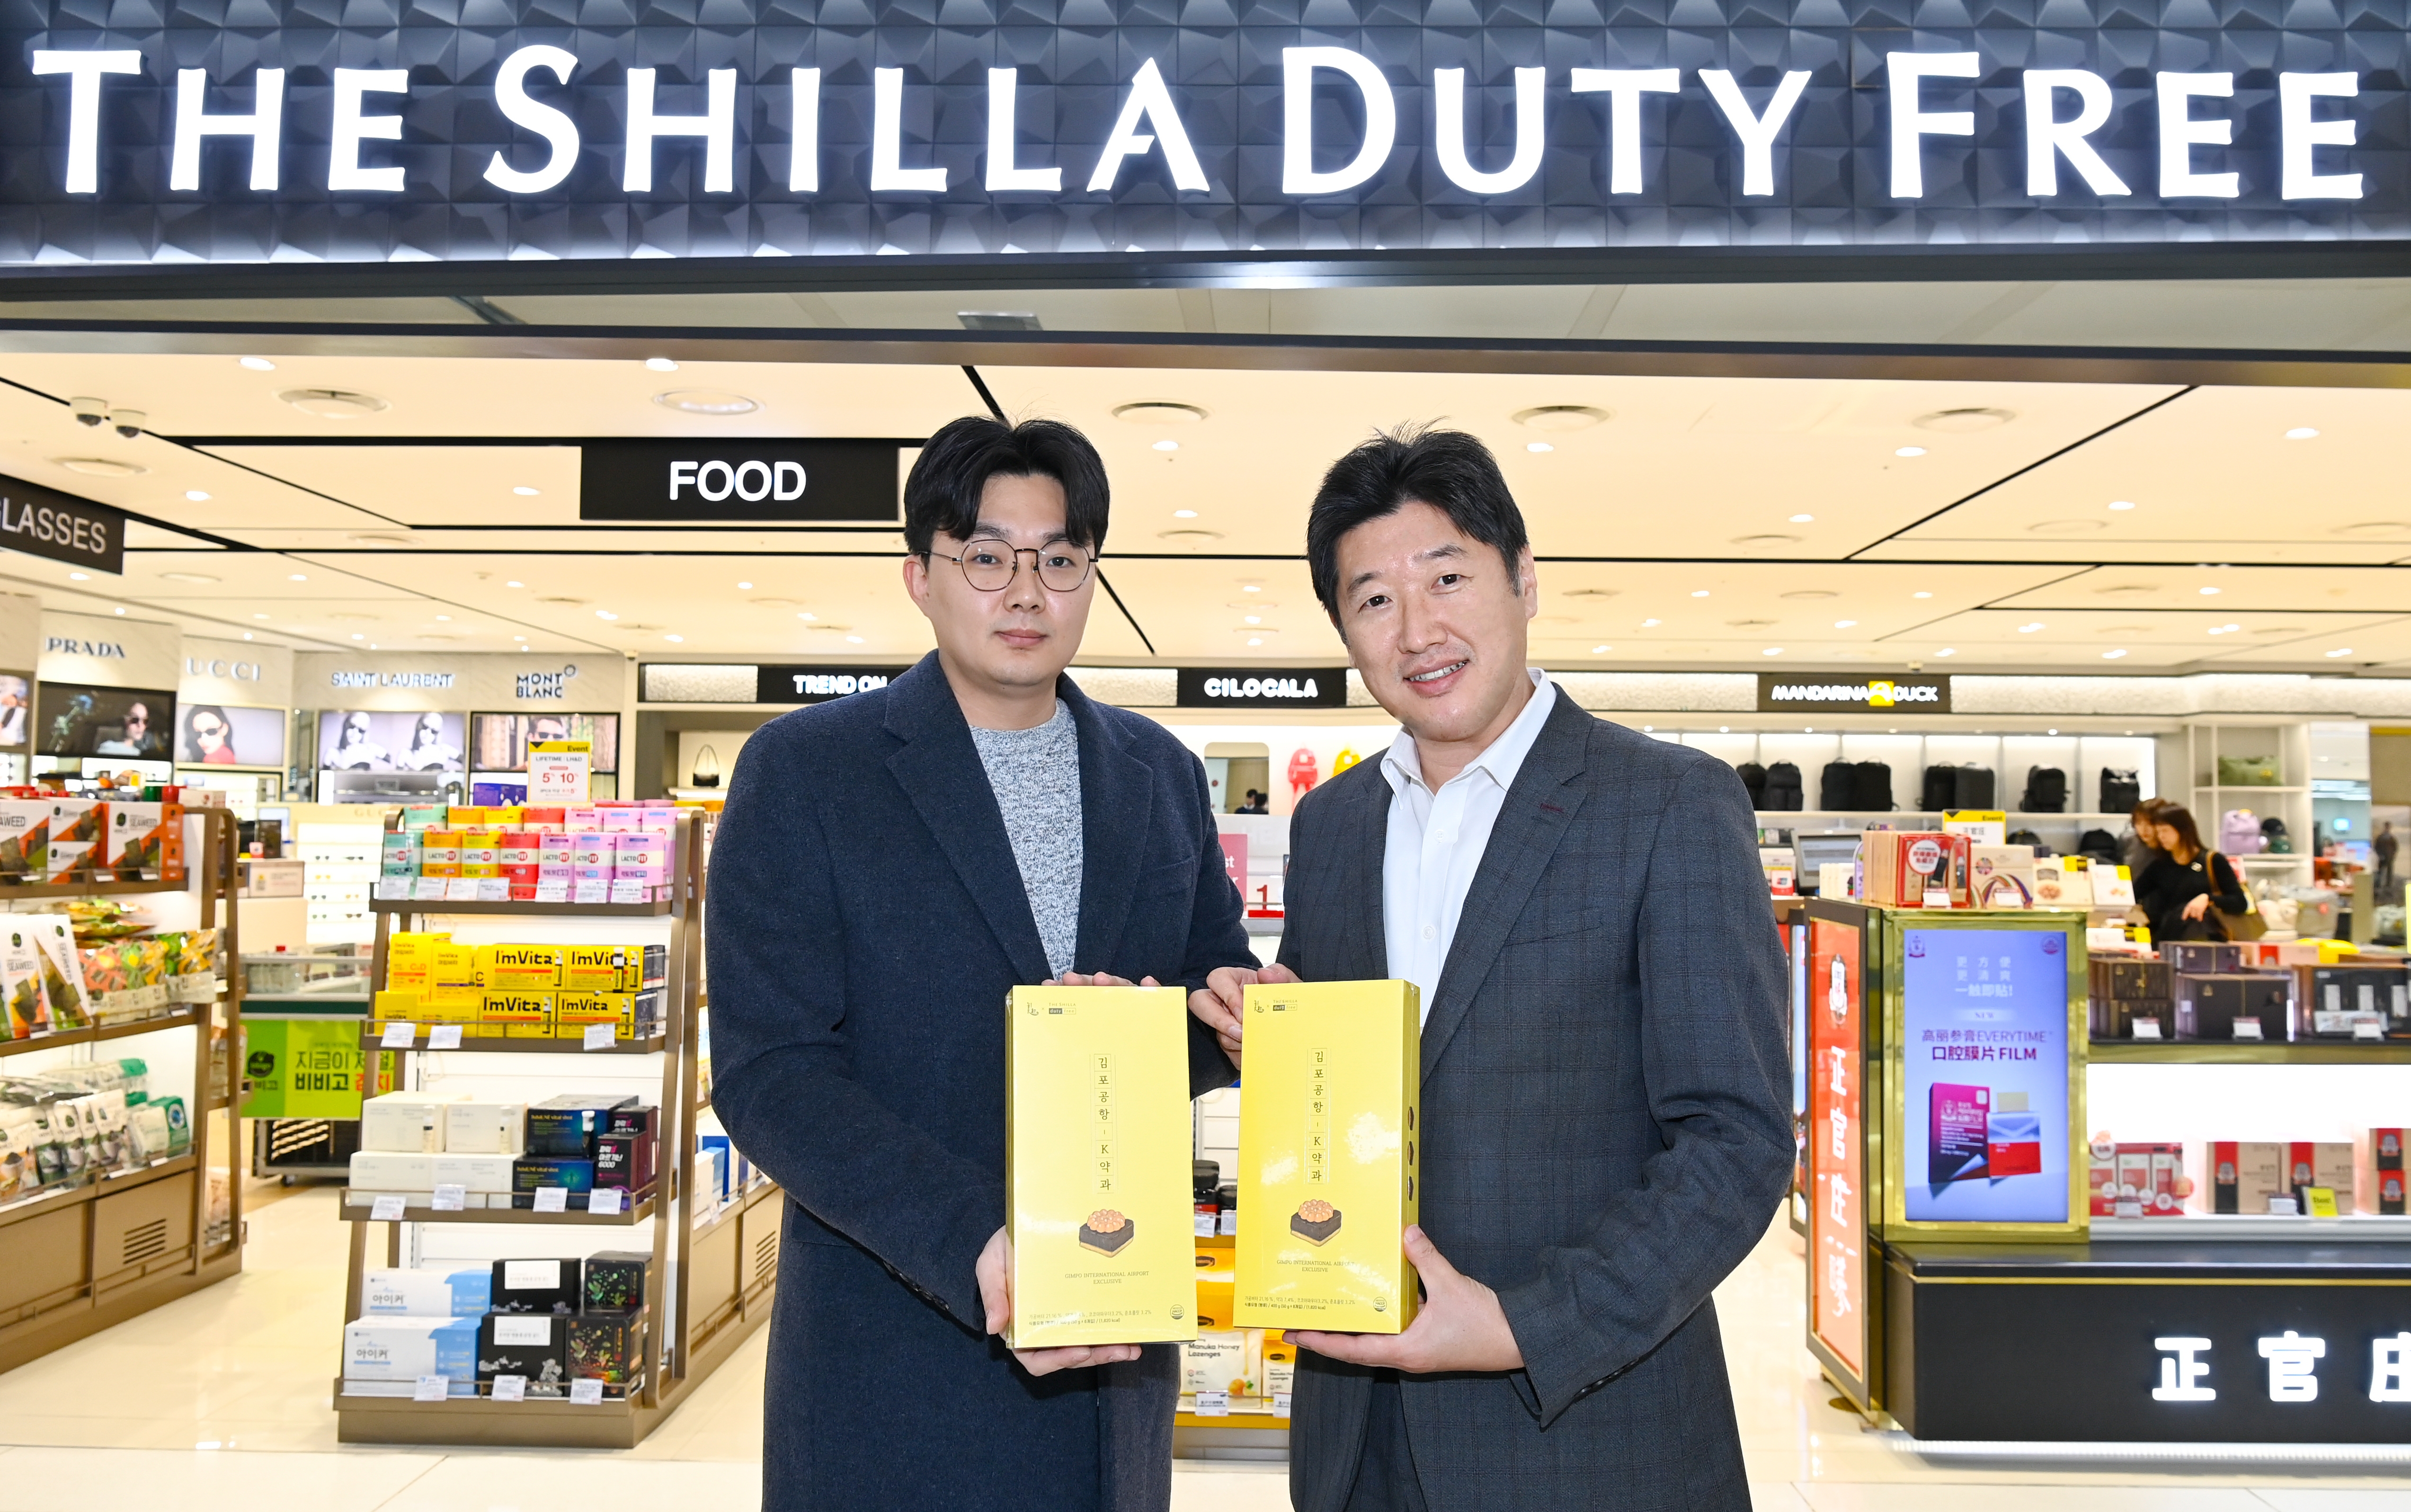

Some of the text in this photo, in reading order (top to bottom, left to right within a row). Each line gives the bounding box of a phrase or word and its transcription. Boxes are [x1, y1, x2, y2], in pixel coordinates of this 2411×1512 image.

[32, 44, 2364, 201] THE SHILLA DUTY FREE
[669, 460, 806, 501] FOOD
[0, 495, 107, 554] LASSES
[46, 636, 125, 658] PRADA
[187, 657, 260, 682] UCCI
[331, 672, 455, 688] SAINT LAURENT
[516, 673, 563, 685] MONT
[793, 675, 888, 694] TREND ON
[1204, 677, 1318, 698] CILOCALA
[516, 686, 562, 698] BLANC
[1771, 685, 1939, 702] MANDARINA DUCK
[1225, 855, 1235, 869] st
[296, 1051, 349, 1069] 지금이
[1999, 1048, 2037, 1060] FILM
[295, 1073, 349, 1091] 비비고
[372, 1294, 404, 1304] 아이커
[356, 1349, 389, 1359] 아이커
